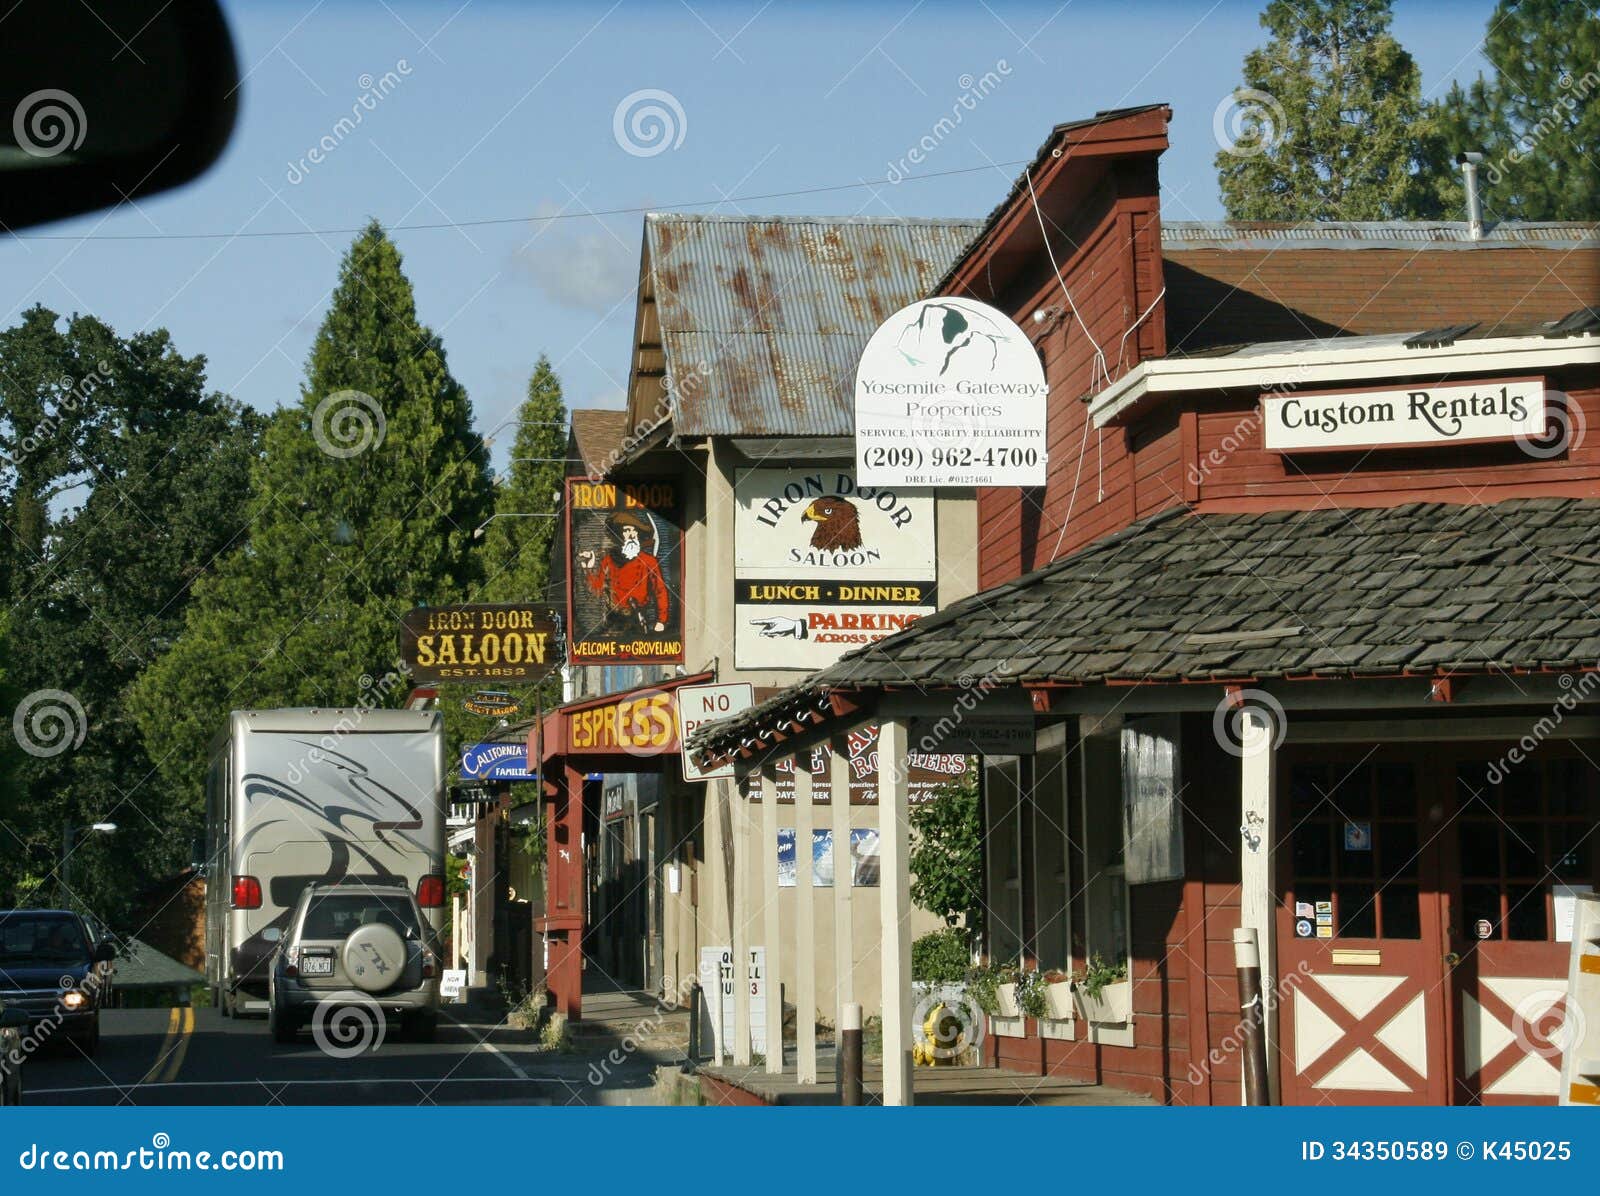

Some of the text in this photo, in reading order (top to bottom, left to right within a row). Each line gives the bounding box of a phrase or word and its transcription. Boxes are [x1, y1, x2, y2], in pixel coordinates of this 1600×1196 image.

[861, 380, 1039, 398] Yosemite Gateway
[905, 402, 1002, 420] Properties
[1280, 386, 1529, 437] Custom Rentals
[972, 429, 1042, 438] RELIABILITY
[863, 446, 1038, 471] (209) 962-4700
[905, 475, 927, 484] DRE
[572, 482, 674, 509] IRON DOOR
[756, 473, 824, 529] IRON
[788, 548, 881, 567] SALOON
[750, 585, 921, 602] LUNCH DINNER
[428, 610, 535, 631] IRON DOOR
[814, 633, 868, 643] ACROSS
[416, 632, 548, 667] SALOON
[572, 641, 616, 656] WELCOME
[631, 641, 682, 656] GROVELAND
[702, 694, 730, 712] NO
[462, 745, 522, 774] CALIFORNIA
[811, 791, 829, 799] EEK
